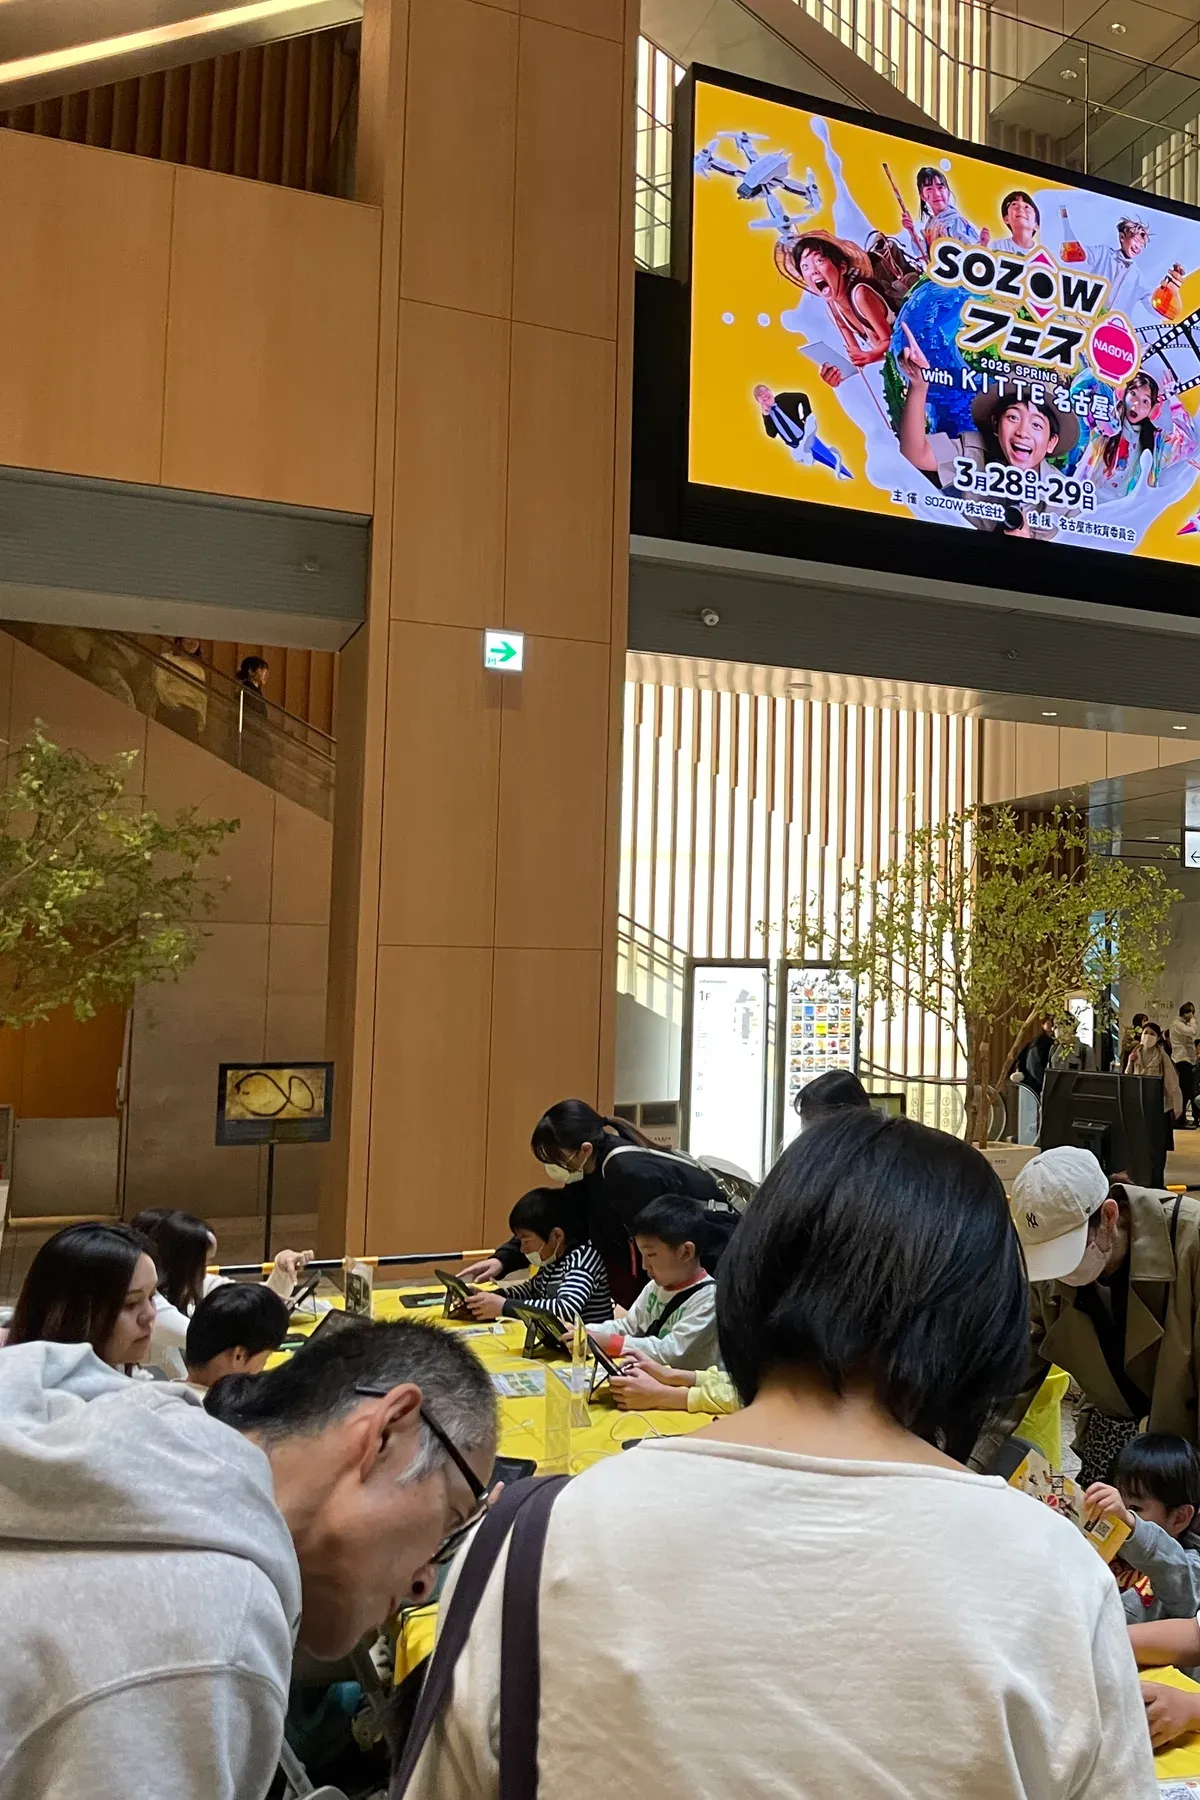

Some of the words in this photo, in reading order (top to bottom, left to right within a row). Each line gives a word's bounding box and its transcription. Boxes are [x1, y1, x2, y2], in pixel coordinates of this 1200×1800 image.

[934, 245, 1104, 313] SOZOW
[963, 308, 1083, 366] フェス
[1093, 338, 1135, 364] NAGOYA
[980, 357, 1011, 374] 2026
[1015, 364, 1058, 384] SPRING
[921, 367, 954, 386] with
[961, 368, 1045, 405] KITTE
[1053, 385, 1111, 421] 名古屋
[1059, 517, 1136, 542] 名古屋市教育委員会
